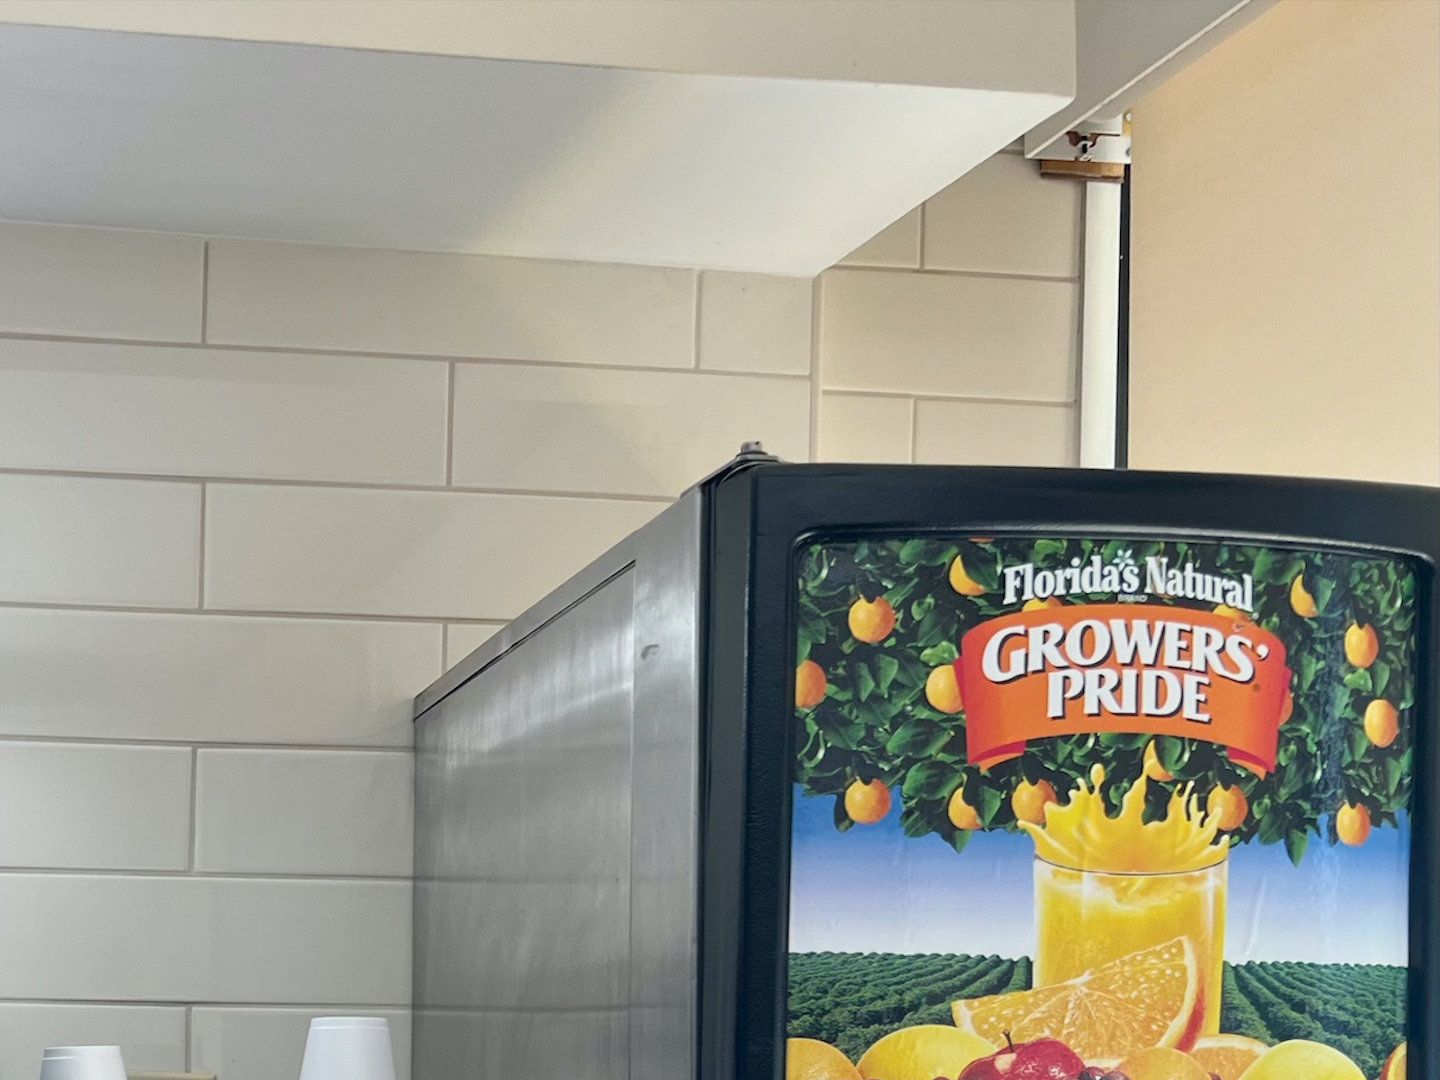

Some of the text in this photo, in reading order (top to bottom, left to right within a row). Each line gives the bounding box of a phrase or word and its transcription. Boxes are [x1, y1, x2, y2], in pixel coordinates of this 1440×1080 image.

[1003, 555, 1253, 612] Florida's Natural
[982, 618, 1270, 684] GROWERS'
[1047, 668, 1211, 723] PRIDE
